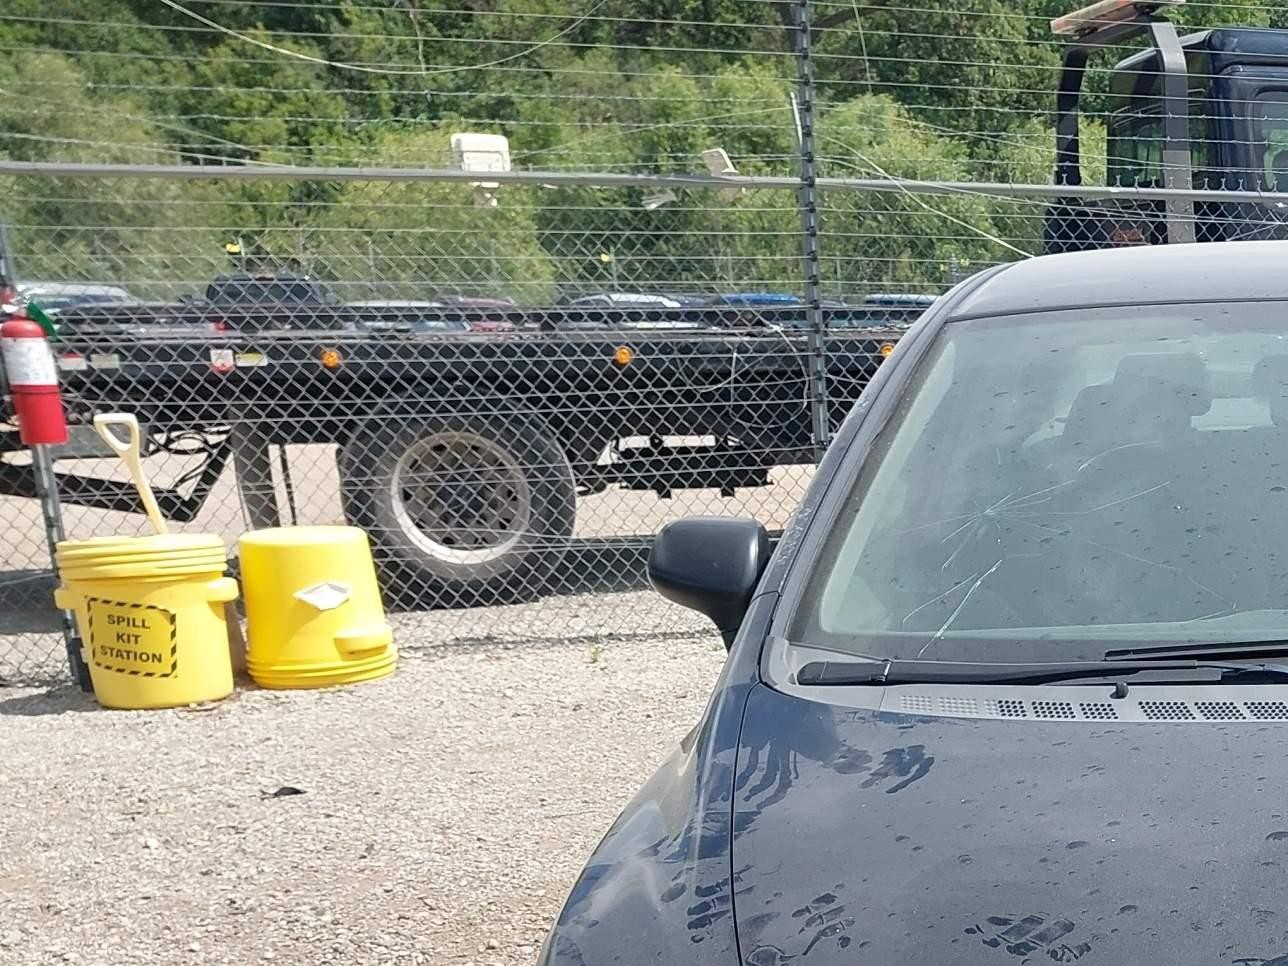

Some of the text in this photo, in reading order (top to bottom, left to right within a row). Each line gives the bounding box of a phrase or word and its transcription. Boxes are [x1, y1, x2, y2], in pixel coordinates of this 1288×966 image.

[107, 614, 151, 629] SPILL
[116, 632, 142, 645] KIT
[100, 645, 163, 664] STATION
